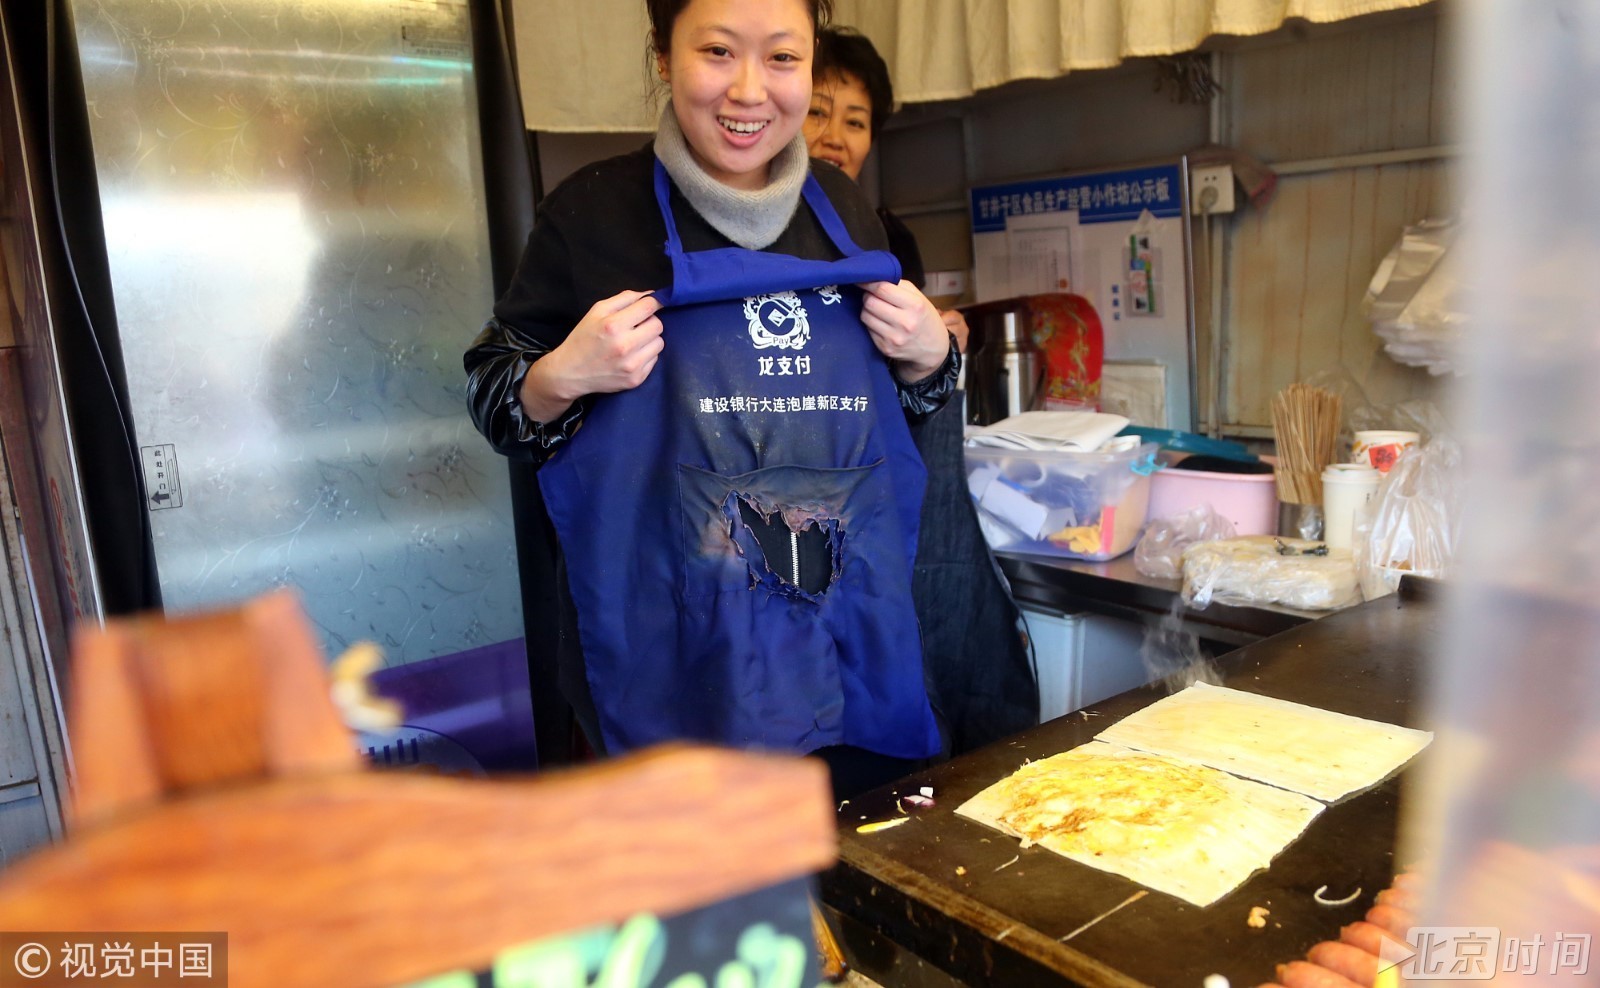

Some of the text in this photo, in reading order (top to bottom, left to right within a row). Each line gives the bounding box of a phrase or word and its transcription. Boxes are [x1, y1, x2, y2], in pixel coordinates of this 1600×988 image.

[773, 336, 790, 346] Pay
[758, 355, 811, 376] 龙支付
[699, 395, 868, 413] 建设银行大连泡崖新区支行
